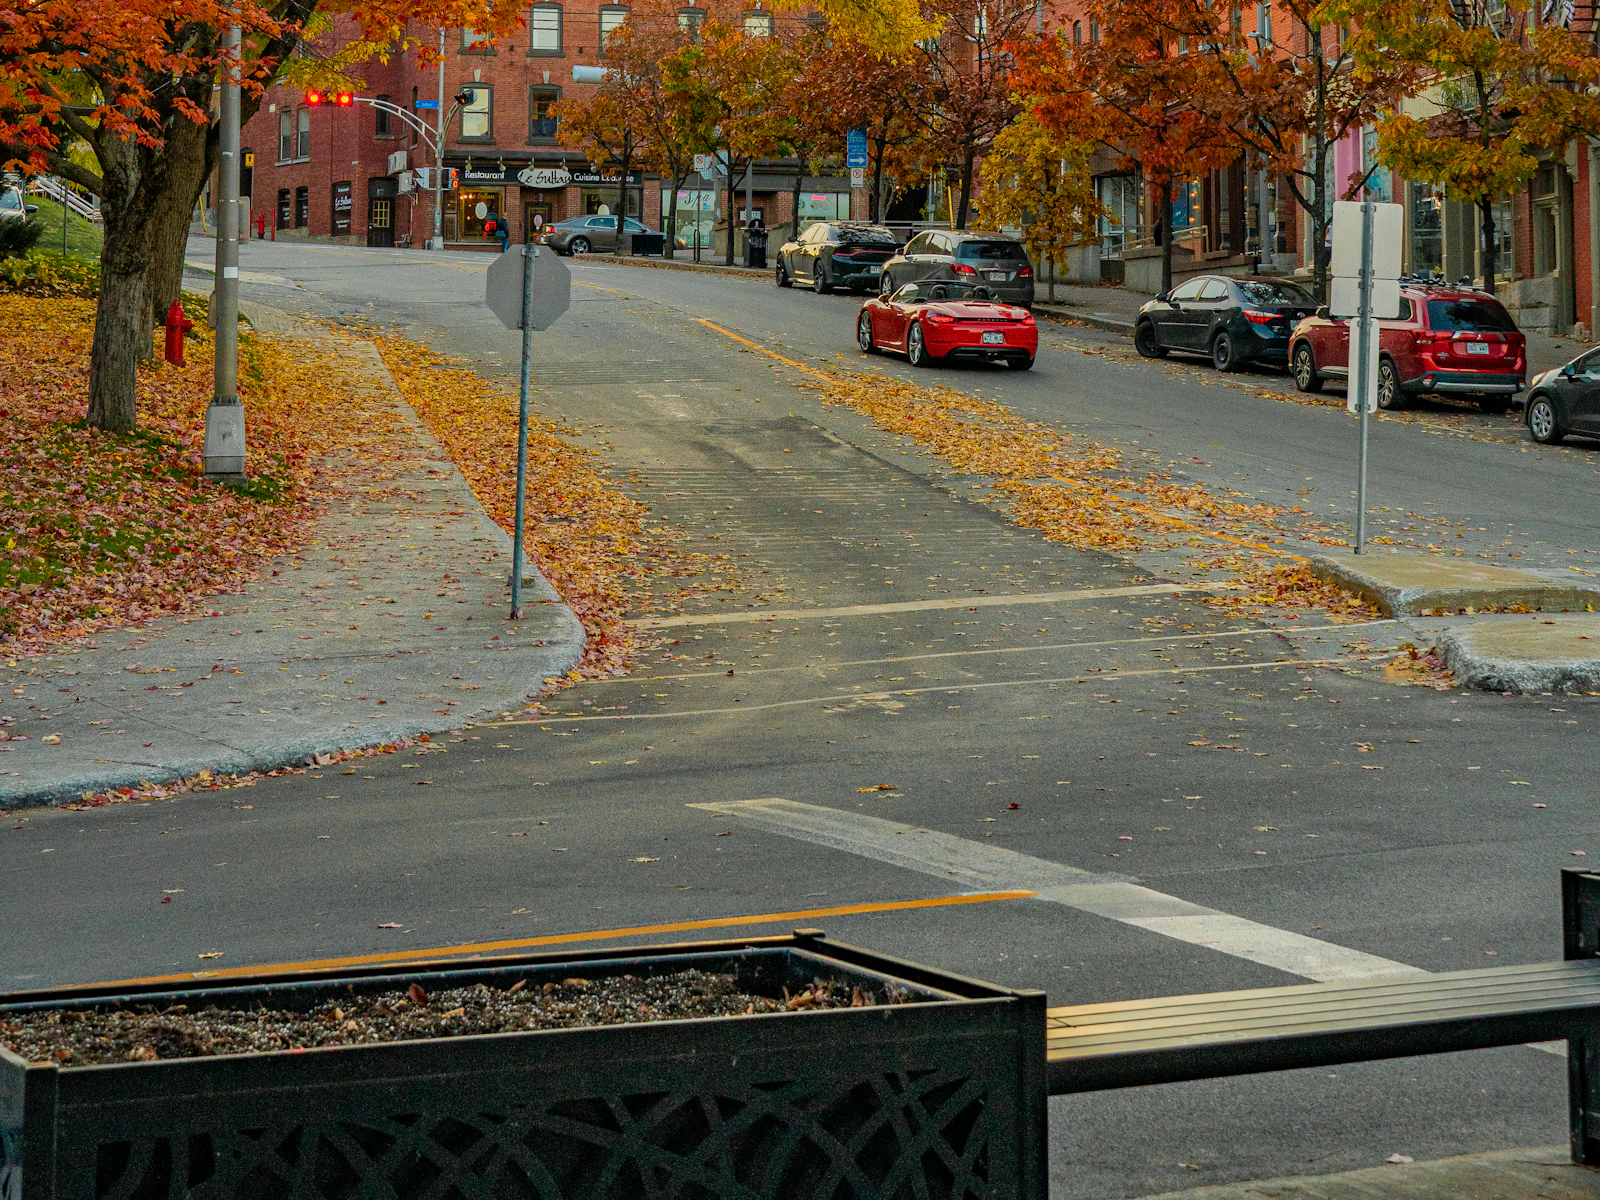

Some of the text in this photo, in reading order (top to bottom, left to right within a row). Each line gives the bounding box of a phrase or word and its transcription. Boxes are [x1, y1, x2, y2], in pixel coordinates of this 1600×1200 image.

[465, 170, 504, 179] Restaurant
[518, 170, 571, 184] Le Sultan
[574, 173, 600, 181] Cuisine
